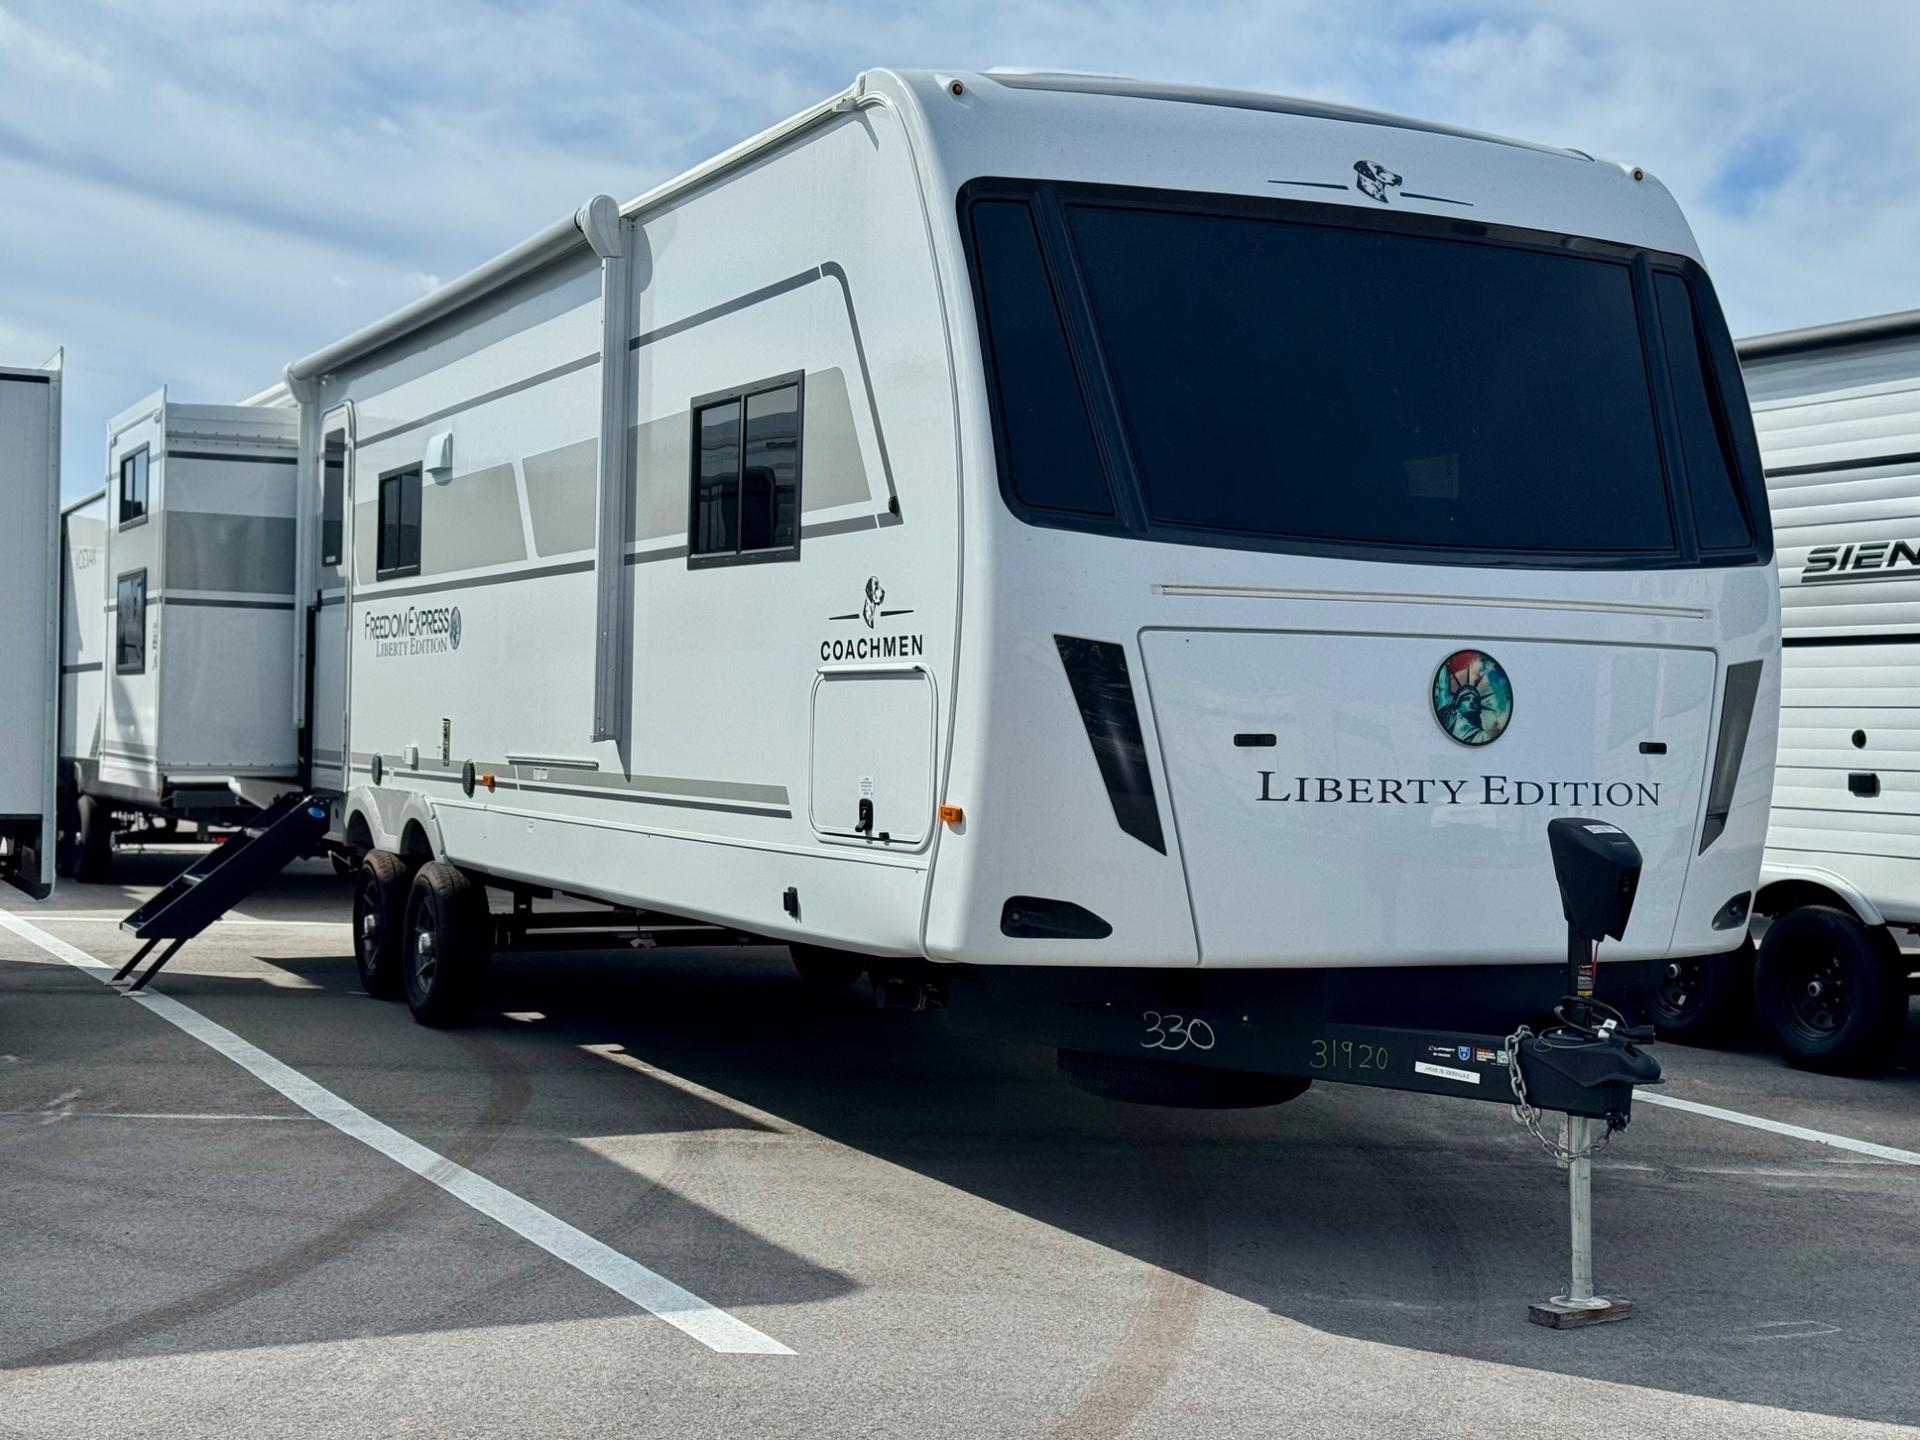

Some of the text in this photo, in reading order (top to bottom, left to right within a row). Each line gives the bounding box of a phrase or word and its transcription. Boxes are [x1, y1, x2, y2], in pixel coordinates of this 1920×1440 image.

[375, 637, 447, 657] LIBERTY EDITION
[820, 634, 923, 661] COACHMEN
[1256, 770, 1661, 807] LIBERTY EDITION
[1140, 1010, 1215, 1050] 330
[1310, 1039, 1388, 1070] 31920
